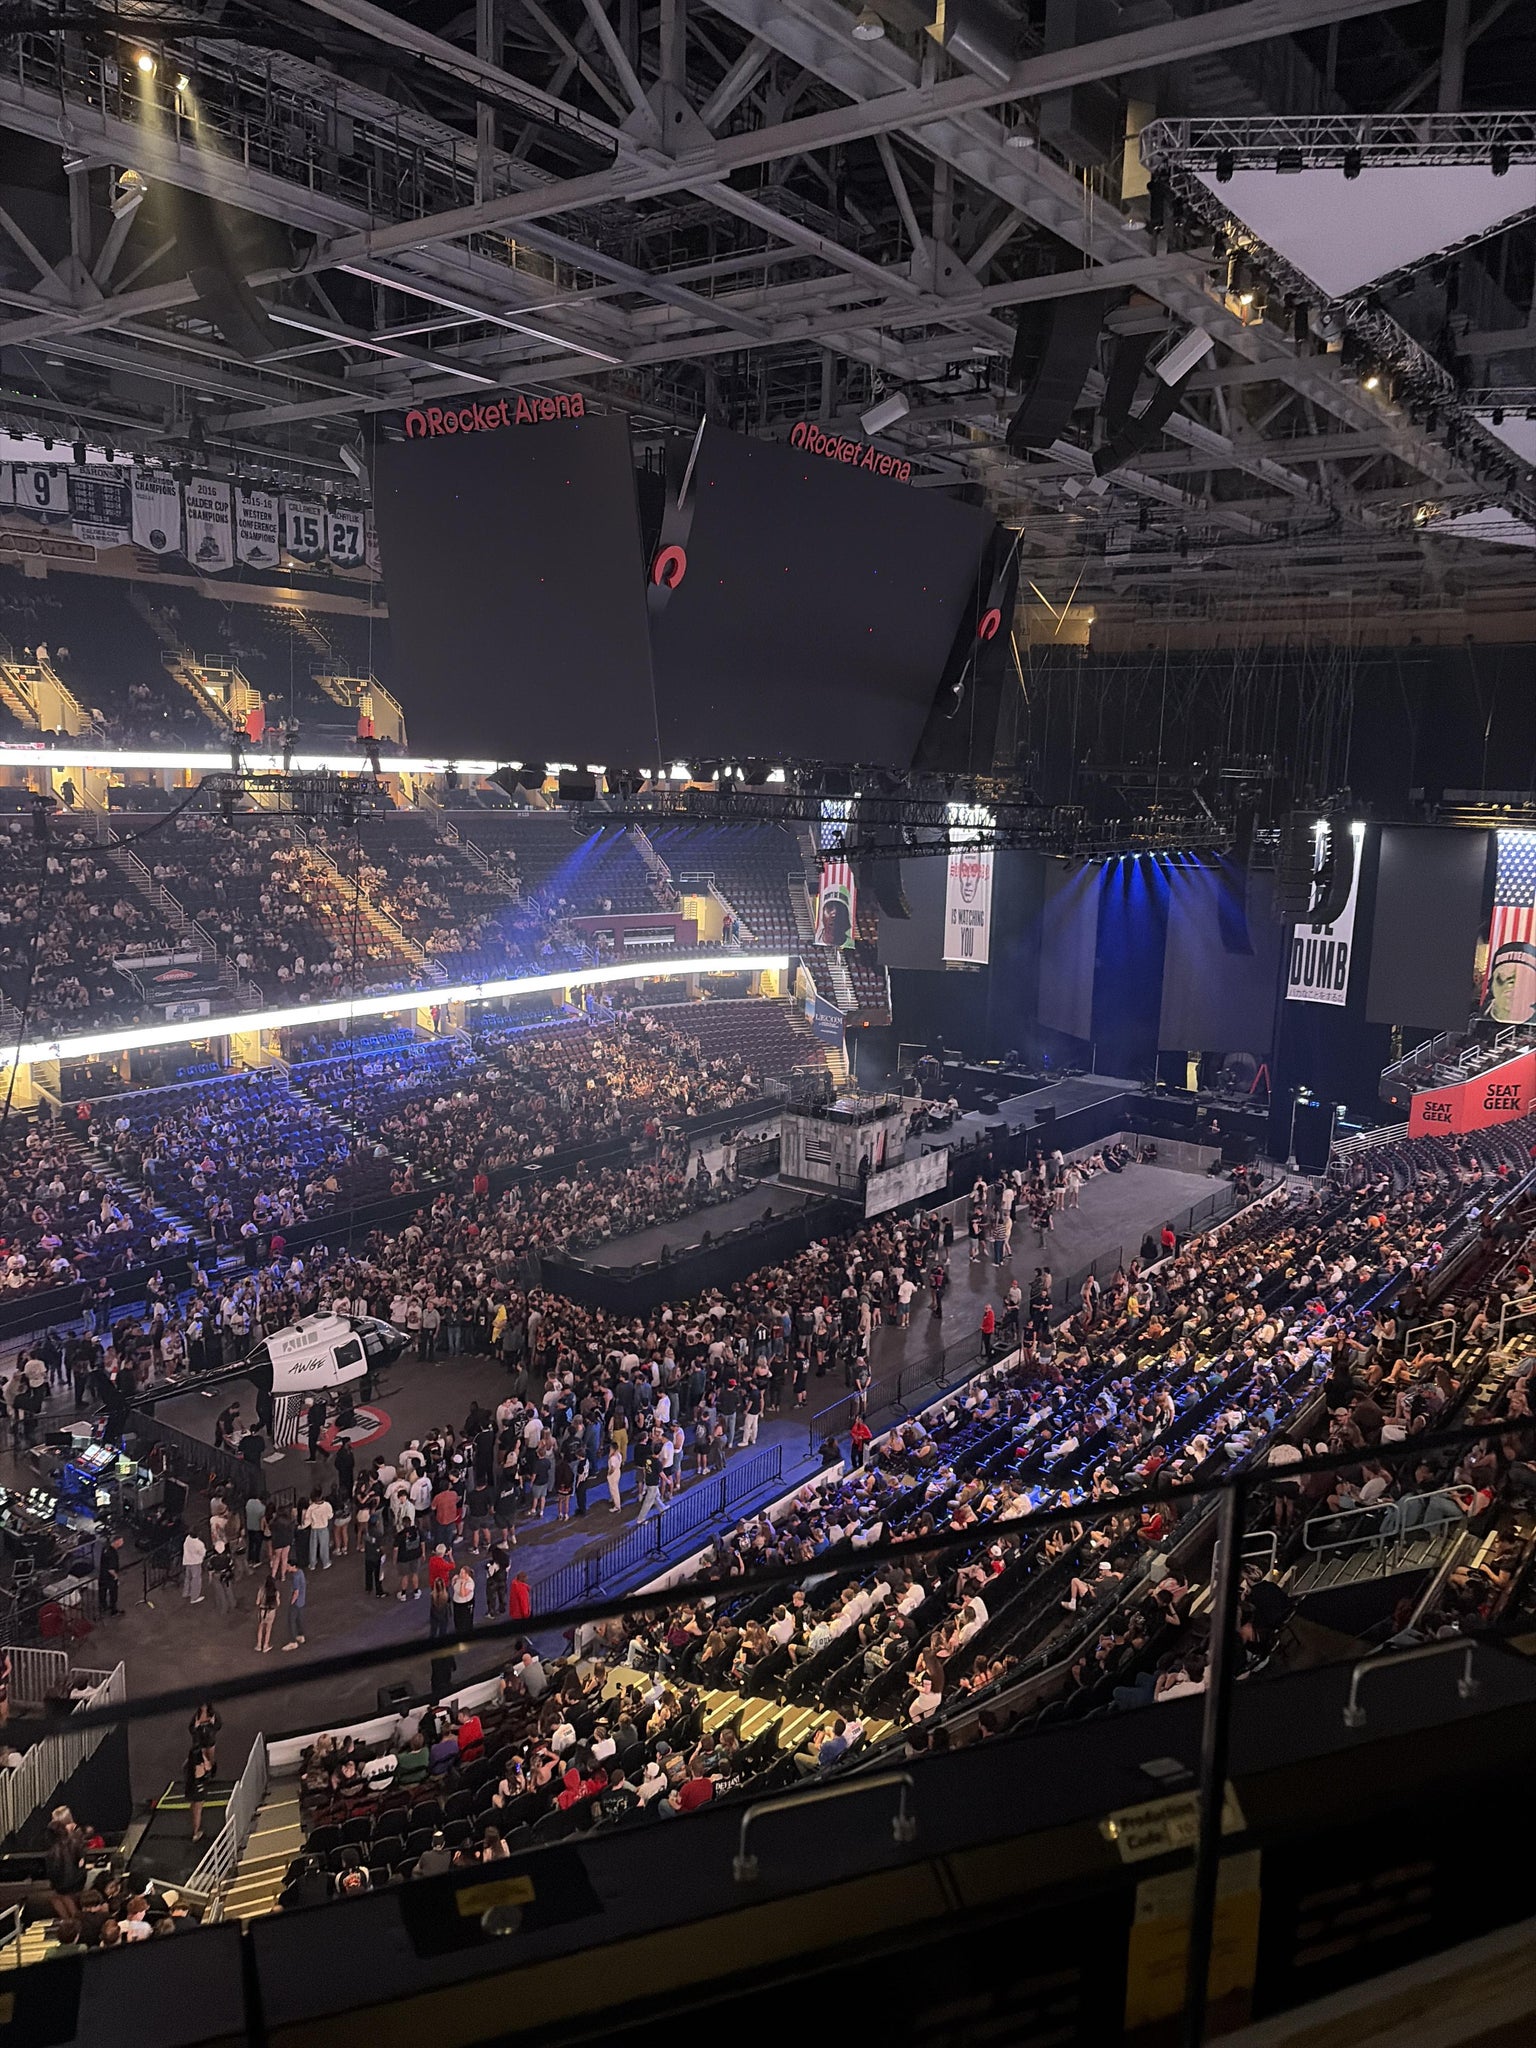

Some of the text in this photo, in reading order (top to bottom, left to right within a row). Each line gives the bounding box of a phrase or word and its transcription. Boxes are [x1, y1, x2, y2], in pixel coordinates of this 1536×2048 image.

[427, 393, 585, 436] Rocket Arena
[804, 426, 912, 482] Rocket Arena
[34, 471, 50, 505] 9
[135, 481, 176, 496] CHAMPIONS
[197, 485, 217, 496] 2016
[187, 496, 229, 512] CALDER CUP
[242, 496, 272, 508] 2015-16
[188, 509, 229, 524] CHAMPIONS
[243, 508, 272, 520] WESTERN
[239, 519, 277, 533] CONFERENCE
[293, 516, 318, 547] 15
[240, 530, 276, 543] CHAMPIONS
[333, 524, 358, 554] 27
[951, 908, 985, 927] IS WATCHING
[960, 927, 974, 957] YOU
[1290, 938, 1348, 990] DUMB
[815, 1013, 843, 1024] LECOM
[1487, 1084, 1521, 1096] SEAT
[1425, 1101, 1452, 1112] SEAT
[1484, 1098, 1521, 1110] GEEK
[1422, 1112, 1452, 1123] GEEK
[758, 1329, 767, 1341] 11
[288, 1356, 327, 1375] AWGE
